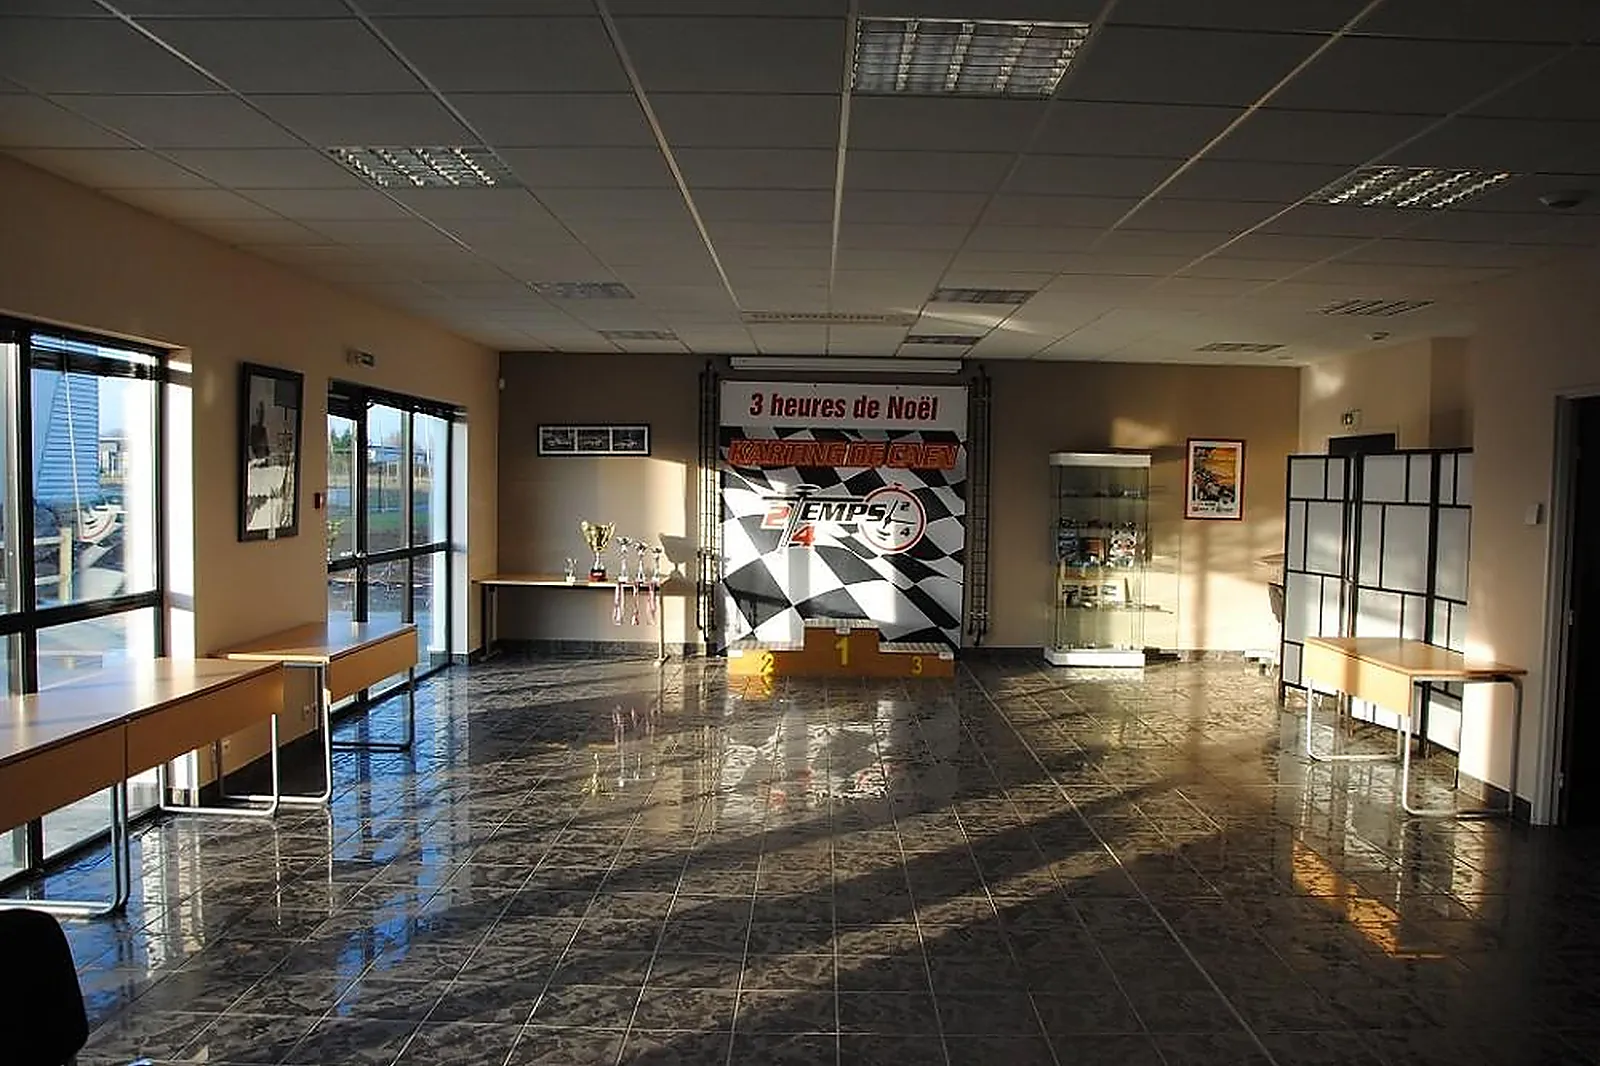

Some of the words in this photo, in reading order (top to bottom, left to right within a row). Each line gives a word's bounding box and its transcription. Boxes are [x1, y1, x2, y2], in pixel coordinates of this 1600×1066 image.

[750, 393, 763, 416] 3
[770, 393, 846, 419] heures
[853, 395, 879, 419] de
[887, 396, 939, 421] Noël
[765, 503, 790, 527] 2
[791, 524, 816, 547] 4
[835, 636, 848, 666] 1
[760, 653, 774, 674] 2
[912, 655, 922, 675] 3
